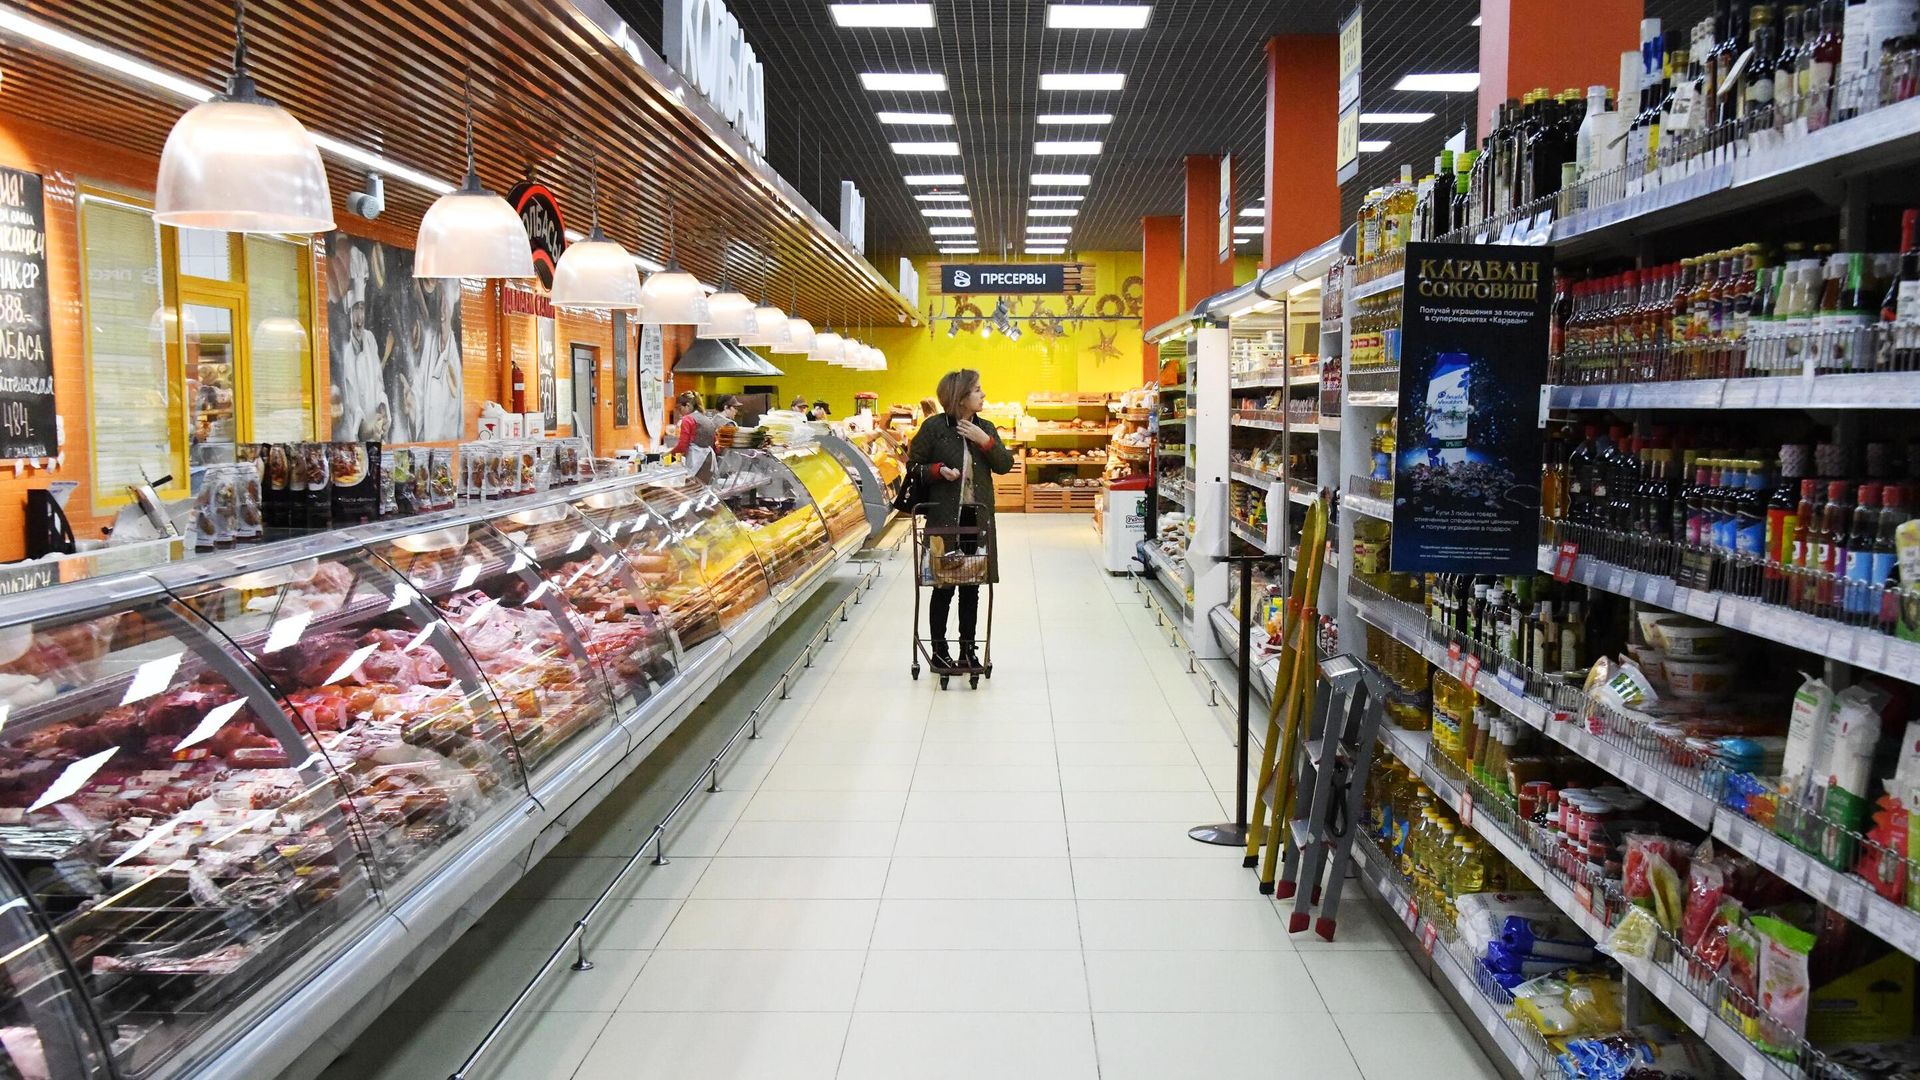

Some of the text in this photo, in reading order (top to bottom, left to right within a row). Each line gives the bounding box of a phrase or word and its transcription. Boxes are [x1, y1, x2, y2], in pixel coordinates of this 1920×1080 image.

[1418, 259, 1540, 281] КАРАВАН
[980, 272, 1046, 285] ПРЕСЕРВЫ
[1420, 306, 1450, 315] Получай
[1452, 308, 1493, 318] украшения
[1504, 310, 1534, 318] покупки
[1431, 316, 1487, 324] супермаркетах
